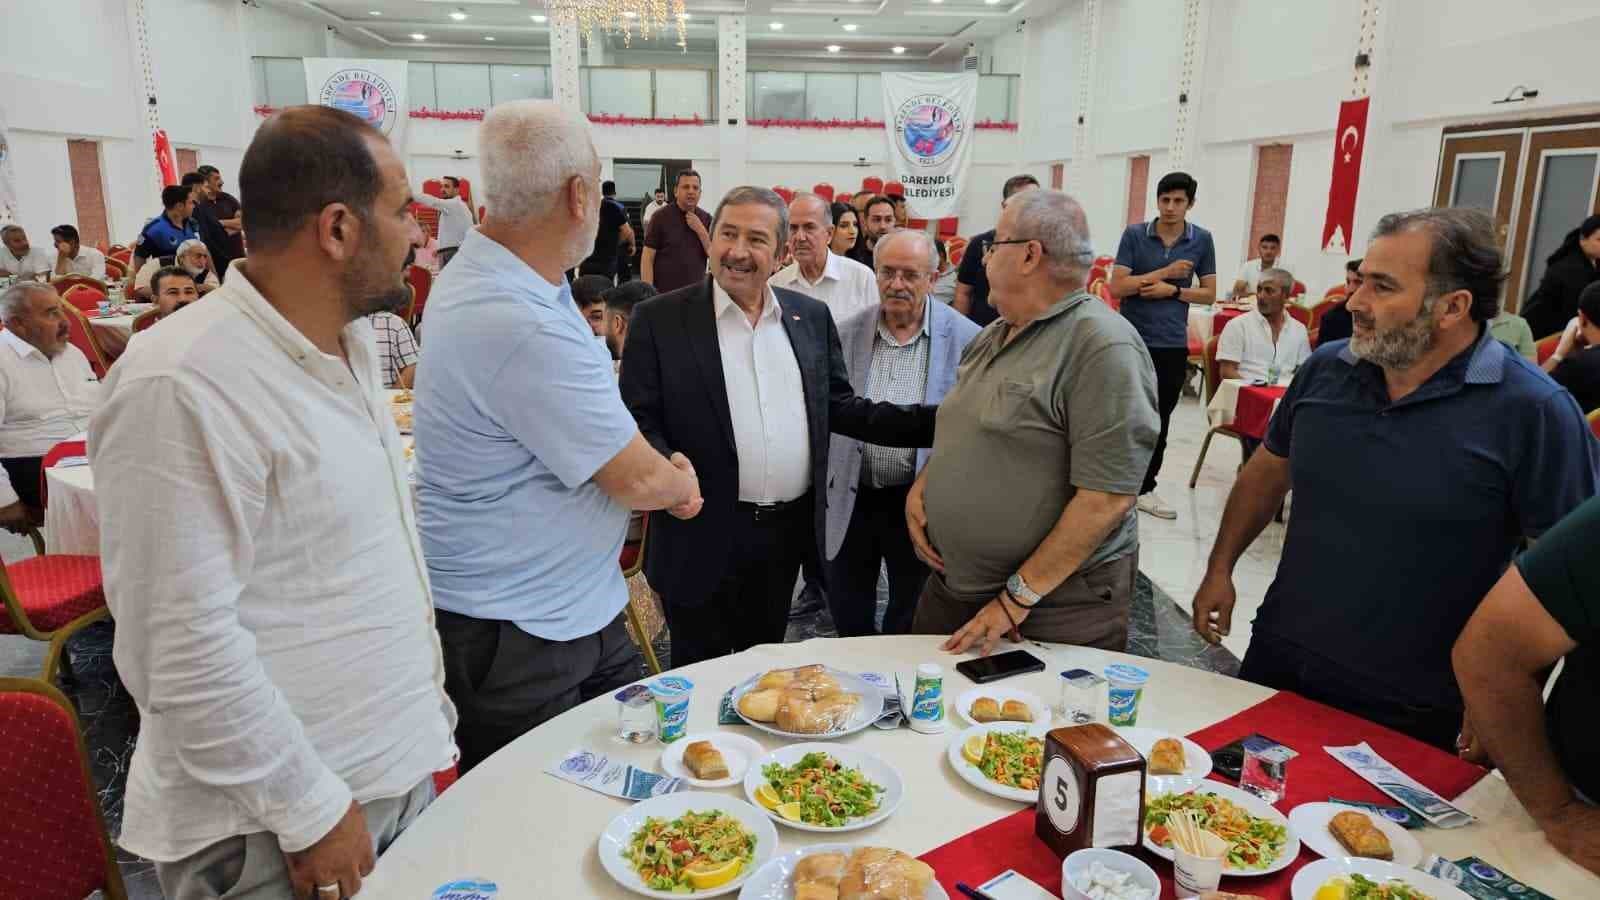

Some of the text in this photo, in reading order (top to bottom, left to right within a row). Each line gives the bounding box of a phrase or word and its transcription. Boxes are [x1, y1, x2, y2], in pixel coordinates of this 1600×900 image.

[901, 175, 952, 184] DARENDE
[904, 185, 955, 198] ELEDİYESİ
[1054, 775, 1069, 812] 5
